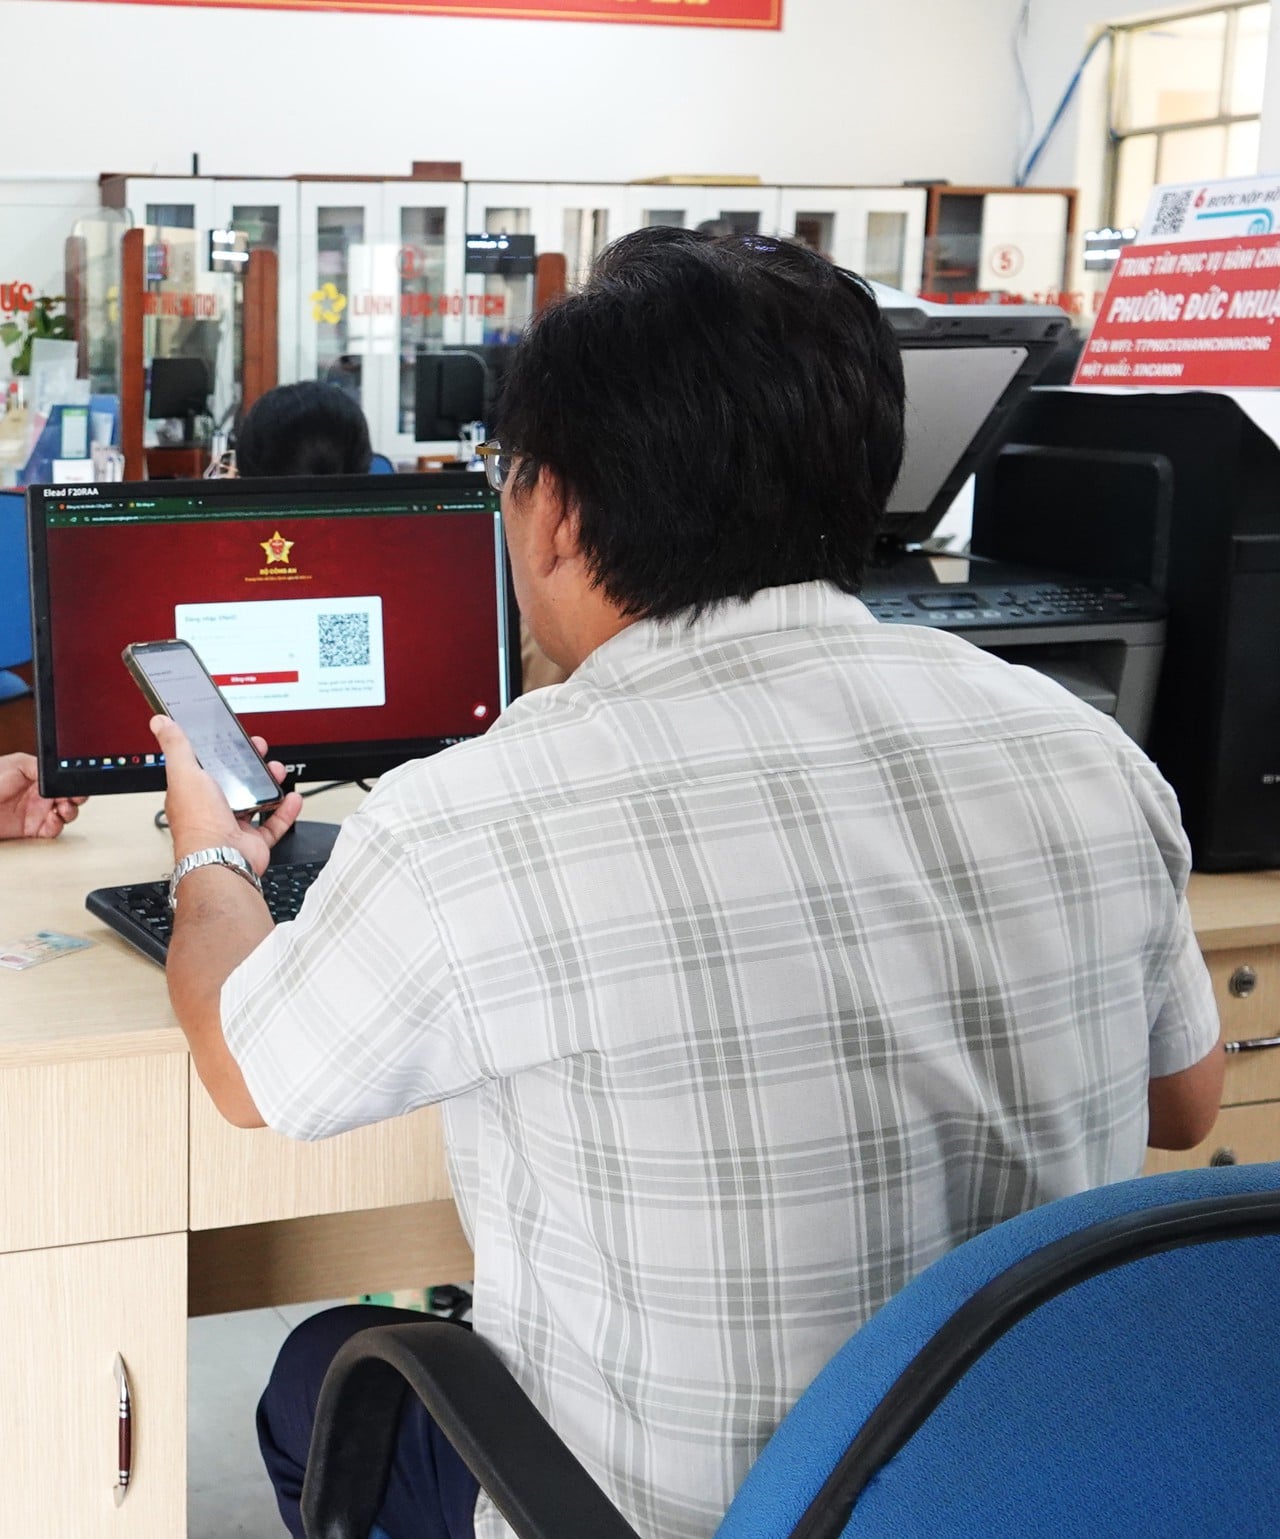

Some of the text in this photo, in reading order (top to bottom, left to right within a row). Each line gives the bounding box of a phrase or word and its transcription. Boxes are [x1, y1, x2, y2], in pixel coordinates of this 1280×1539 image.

[1106, 288, 1185, 324] PHƯỜNG
[1182, 284, 1229, 321] ĐỨC
[43, 488, 67, 498] Elead
[284, 763, 307, 776] PT
